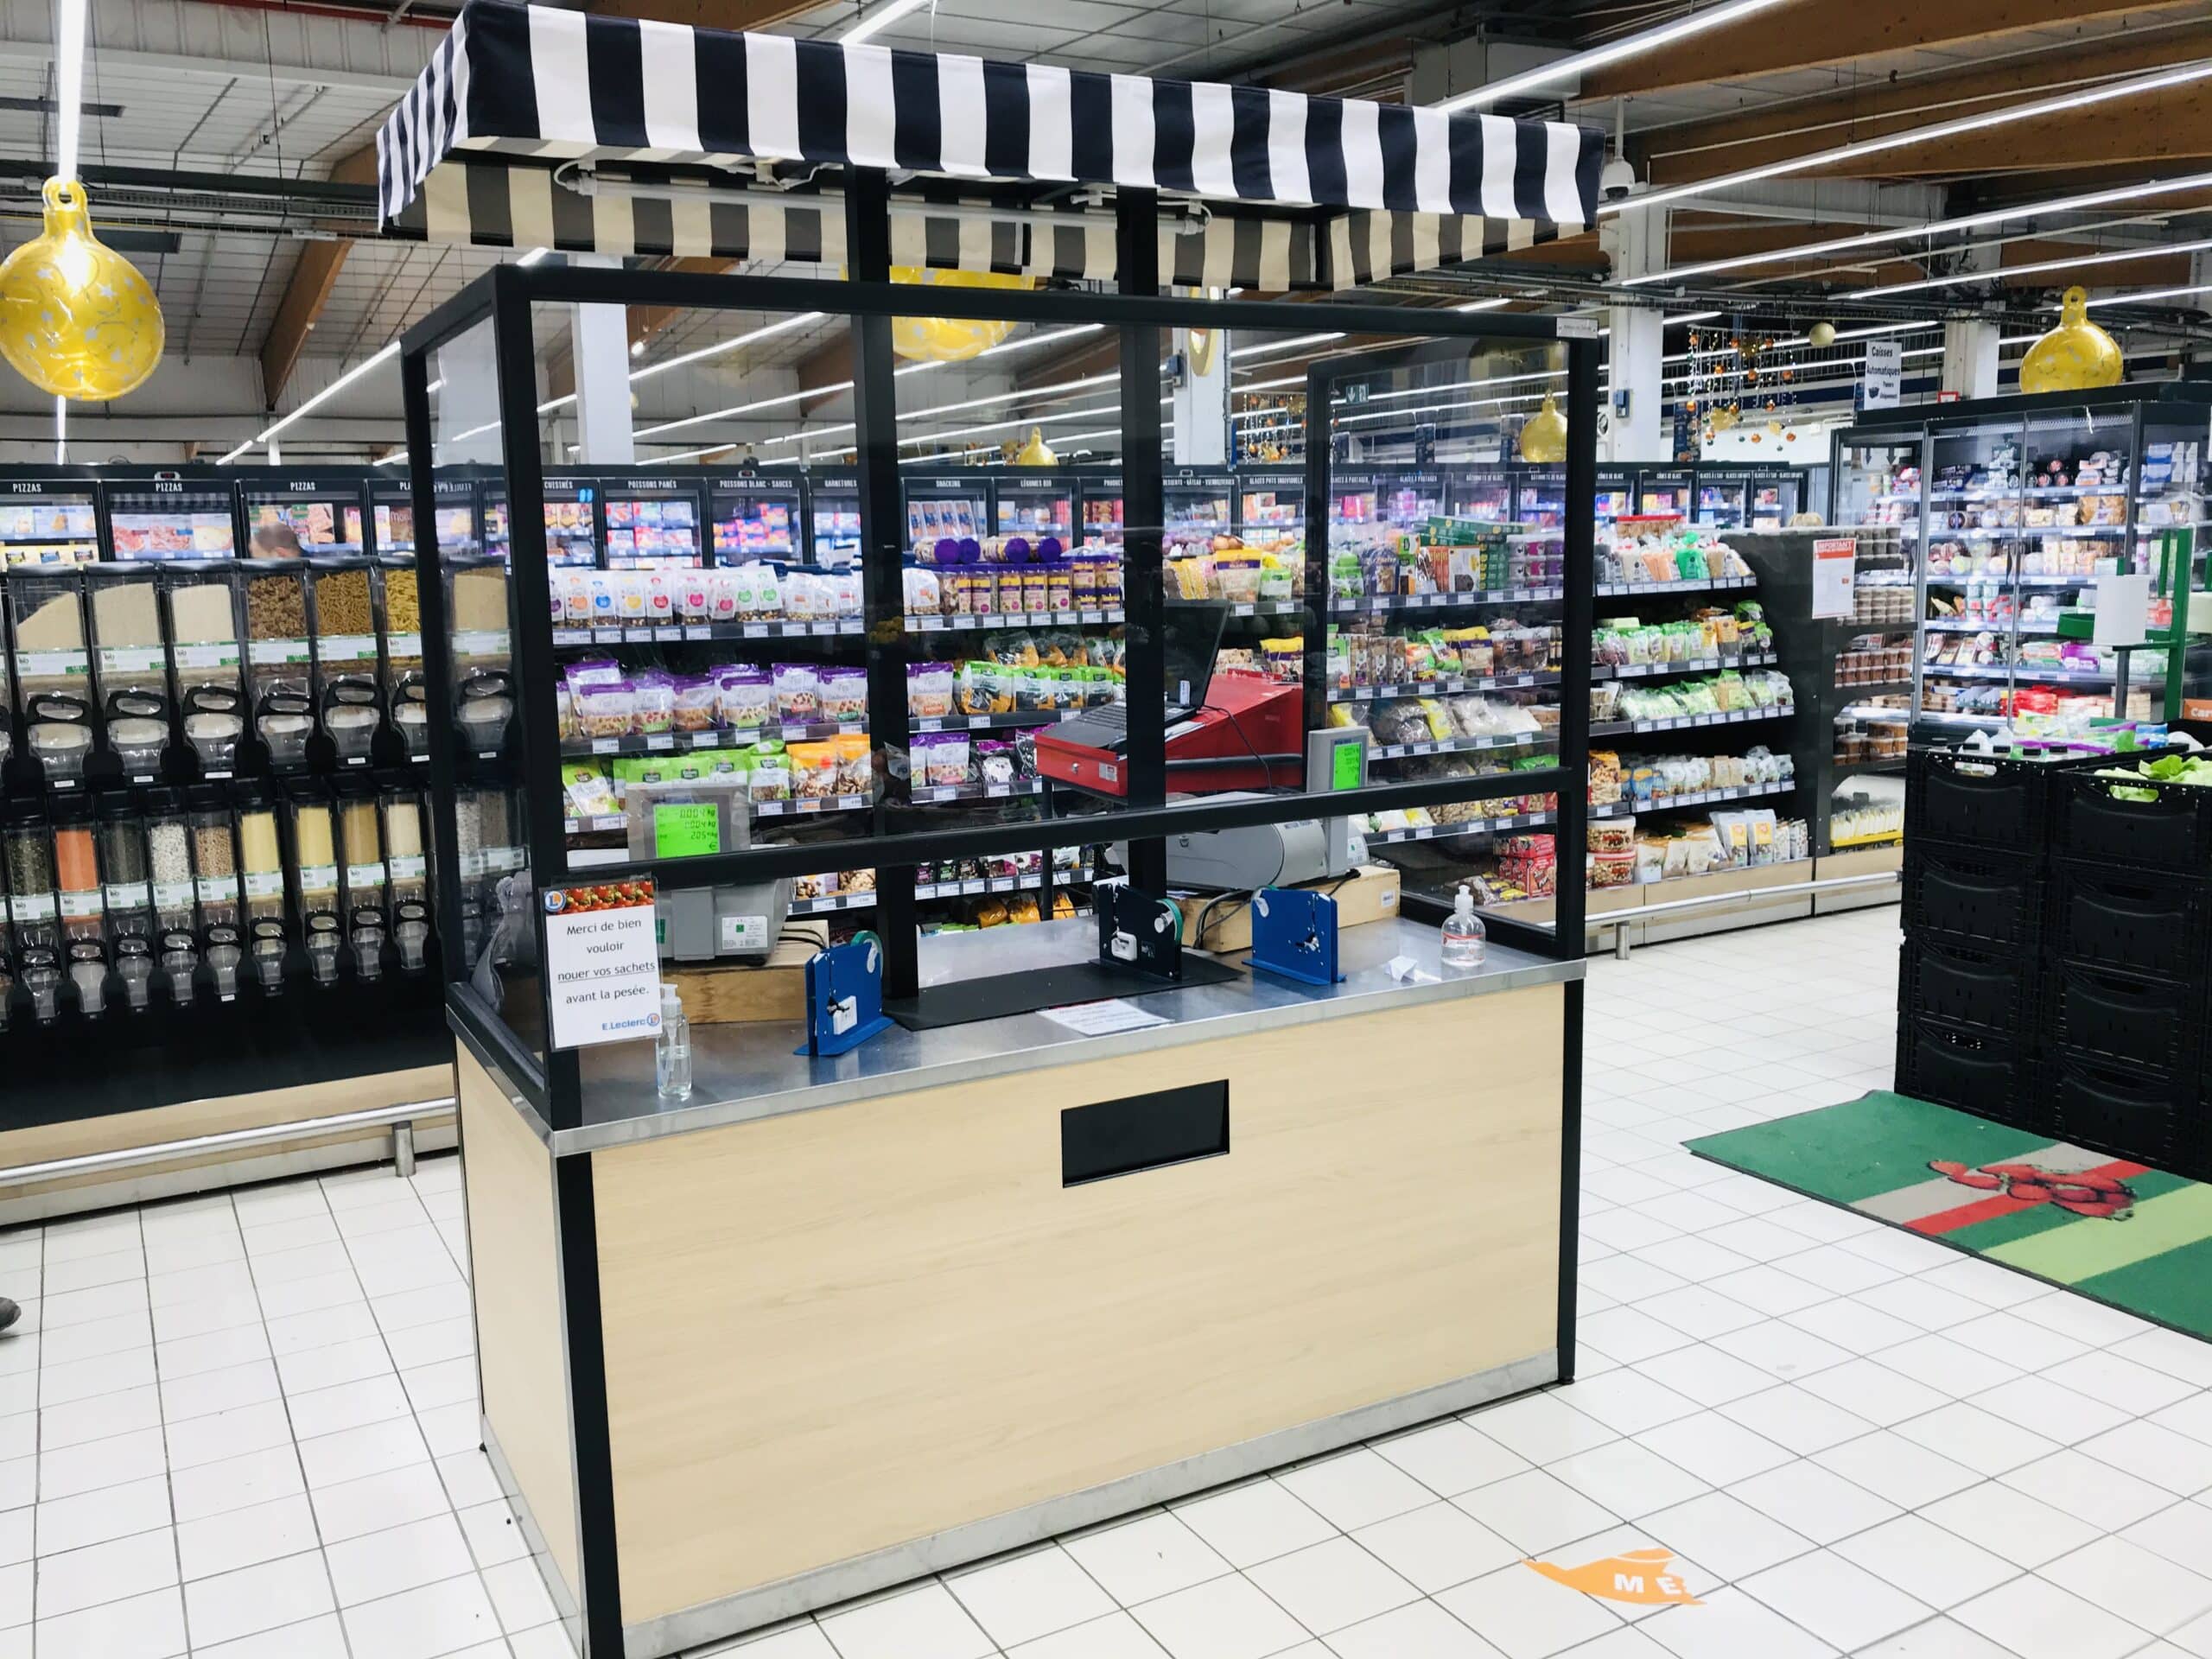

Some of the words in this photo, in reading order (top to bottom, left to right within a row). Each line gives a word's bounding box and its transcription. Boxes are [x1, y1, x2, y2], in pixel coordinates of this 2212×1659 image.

[1872, 346, 1893, 357] Caisses
[1866, 365, 1901, 377] Automatiques
[13, 484, 41, 493] PIZZAS
[156, 483, 183, 492] PIZZAS
[290, 482, 315, 491] PIZZAS
[628, 480, 657, 489] POISSONS
[658, 480, 677, 488] PANÉS
[720, 480, 748, 488] POISSONS
[567, 923, 597, 936] Merci
[601, 922, 614, 932] de
[618, 918, 641, 929] bien
[587, 941, 624, 954] vouloir
[557, 969, 589, 982] nouer
[594, 967, 611, 977] vos
[614, 960, 655, 975] sachets
[566, 991, 595, 1004] avant
[601, 989, 610, 1000] la
[613, 986, 649, 1001] pesée.
[601, 1019, 645, 1031] E.Leclerc
